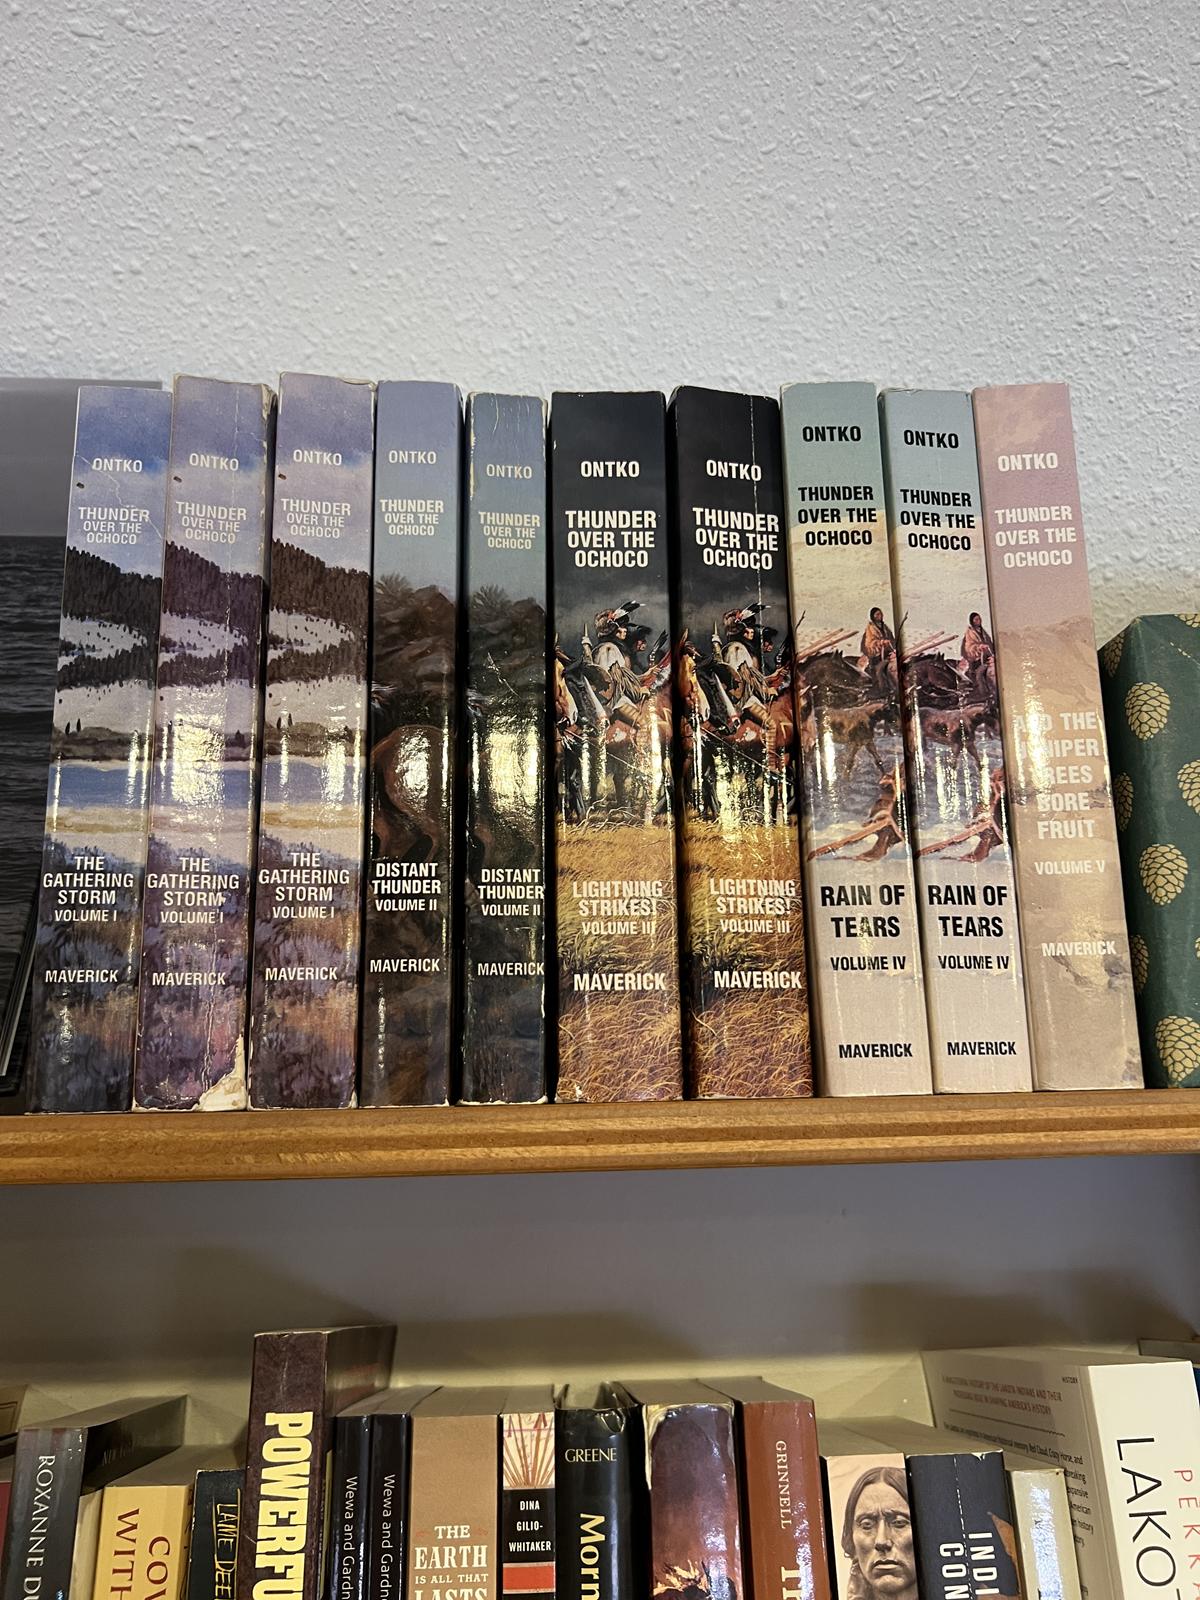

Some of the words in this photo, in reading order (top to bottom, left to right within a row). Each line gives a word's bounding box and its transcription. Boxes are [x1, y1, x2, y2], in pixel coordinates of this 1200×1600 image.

[802, 425, 862, 442] ONTKO
[903, 429, 959, 449] ONTKO
[92, 458, 143, 473] ONTKO
[189, 453, 239, 471] ONTKO
[293, 449, 343, 466] ONTKO
[388, 450, 437, 465] ONTKO
[997, 452, 1059, 472] ONTKO
[486, 464, 533, 479] ONTKO
[580, 461, 640, 478] ONTKO
[706, 459, 762, 482] ONTKO
[798, 486, 874, 502] THUNDER
[900, 488, 972, 507] THUNDER
[78, 506, 150, 523] THUNDER
[176, 501, 247, 521] THUNDER
[280, 498, 351, 516] THUNDER
[379, 499, 444, 514] THUNDER
[994, 505, 1073, 524] THUNDER
[286, 512, 318, 526] OVER
[321, 514, 345, 528] THE
[384, 513, 414, 525] OVER
[417, 513, 439, 525] THE
[478, 511, 541, 528] THUNDER
[565, 510, 657, 529] THUNDER
[692, 507, 779, 533] THUNDER
[797, 508, 842, 524] OVER
[846, 507, 878, 523] THE
[900, 510, 941, 528] OVER
[945, 513, 976, 529] THE
[83, 521, 114, 534] OVER
[119, 522, 142, 534] THE
[181, 518, 214, 531] OVER
[218, 520, 241, 532] THE
[290, 524, 340, 539] OCHOCO
[388, 524, 435, 536] OCHOCO
[483, 526, 512, 539] OVER
[515, 527, 536, 539] THE
[86, 532, 137, 545] OCHOCO
[185, 529, 236, 544] OCHOCO
[487, 537, 532, 550] OCHOCO
[567, 531, 616, 549] OVER
[620, 531, 655, 548] THE
[695, 528, 741, 549] OVER
[745, 533, 779, 551] THE
[805, 530, 872, 546] OCHOCO
[908, 532, 971, 551] OCHOCO
[995, 529, 1040, 547] OVER
[1044, 526, 1077, 543] THE
[574, 550, 649, 568] OCHOCO
[703, 548, 773, 570] OCHOCO
[1003, 549, 1073, 568] OCHOCO
[1014, 713, 1053, 733] AD
[1059, 711, 1098, 731] THE
[1030, 765, 1093, 785] REES
[1036, 793, 1090, 812] BORE
[1038, 820, 1095, 839] FRUIT
[74, 856, 105, 871] THE
[180, 857, 210, 872] THE
[290, 852, 321, 867] THE
[1034, 861, 1092, 875] VOLUME
[1096, 860, 1105, 873] V
[258, 869, 350, 885] GATHERING
[375, 862, 439, 878] DISTANT
[481, 868, 541, 883] DISTANT
[43, 873, 134, 888] GATHERING
[147, 873, 240, 889] GATHERING
[372, 879, 442, 895] THUNDER
[710, 878, 796, 898] LIGHTNING
[57, 889, 116, 905] STORM
[275, 886, 333, 902] STORM
[478, 885, 545, 900] THUNDER
[572, 880, 663, 899] LIGHTNING
[820, 884, 872, 907] RAIN
[879, 884, 905, 906] OF
[927, 884, 977, 906] RAIN
[982, 885, 1008, 906] OF
[163, 891, 223, 907] STORM
[375, 899, 426, 912] VOLUME
[428, 899, 438, 911] II
[716, 897, 791, 915] STRIKES!
[54, 909, 109, 922] VOLUME
[112, 910, 118, 922] I
[272, 906, 327, 919] VOLUME
[330, 907, 335, 919] I
[481, 904, 529, 917] VOLUME
[532, 905, 541, 917] II
[578, 899, 657, 917] STRIKES!
[160, 911, 215, 924] VOLUME
[219, 912, 224, 924] I
[581, 921, 638, 936] VOLUME
[641, 921, 657, 935] III
[720, 918, 773, 934] VOLUME
[776, 920, 790, 933] III
[830, 915, 900, 938] TEARS
[938, 915, 1004, 937] TEARS
[1041, 941, 1116, 957] MAVERICK
[370, 958, 441, 973] MAVERICK
[477, 962, 545, 976] MAVERICK
[830, 956, 889, 971] VOLUME
[892, 956, 906, 970] IV
[938, 955, 993, 970] VOLUME
[996, 955, 1010, 970] IV
[45, 969, 119, 983] MAVERICK
[152, 972, 226, 986] MAVERICK
[265, 967, 338, 981] MAVERICK
[573, 973, 666, 991] MAVERICK
[714, 970, 802, 989] MAVERICK
[838, 1043, 913, 1059] MAVERICK
[947, 1041, 1017, 1056] MAVERICK
[564, 1447, 617, 1463] GREENE
[775, 1440, 792, 1529] GRINNELL
[344, 1476, 358, 1519] Wewa
[382, 1474, 396, 1517] Wewa
[26, 1455, 55, 1567] ROXANNE
[519, 1501, 540, 1511] DINA
[516, 1521, 543, 1531] GILIO-
[1116, 1437, 1181, 1600] LAKO
[216, 1503, 239, 1552] LAME
[381, 1522, 393, 1548] and
[434, 1525, 470, 1539] THE
[343, 1524, 355, 1550] and
[508, 1541, 551, 1552] WHITAKER
[414, 1545, 487, 1569] EARTH
[415, 1576, 426, 1584] IS
[431, 1574, 452, 1583] ALL
[458, 1573, 488, 1583] THAT
[939, 1543, 970, 1600] CON
[23, 1576, 42, 1600] D
[213, 1561, 237, 1600] DEE
